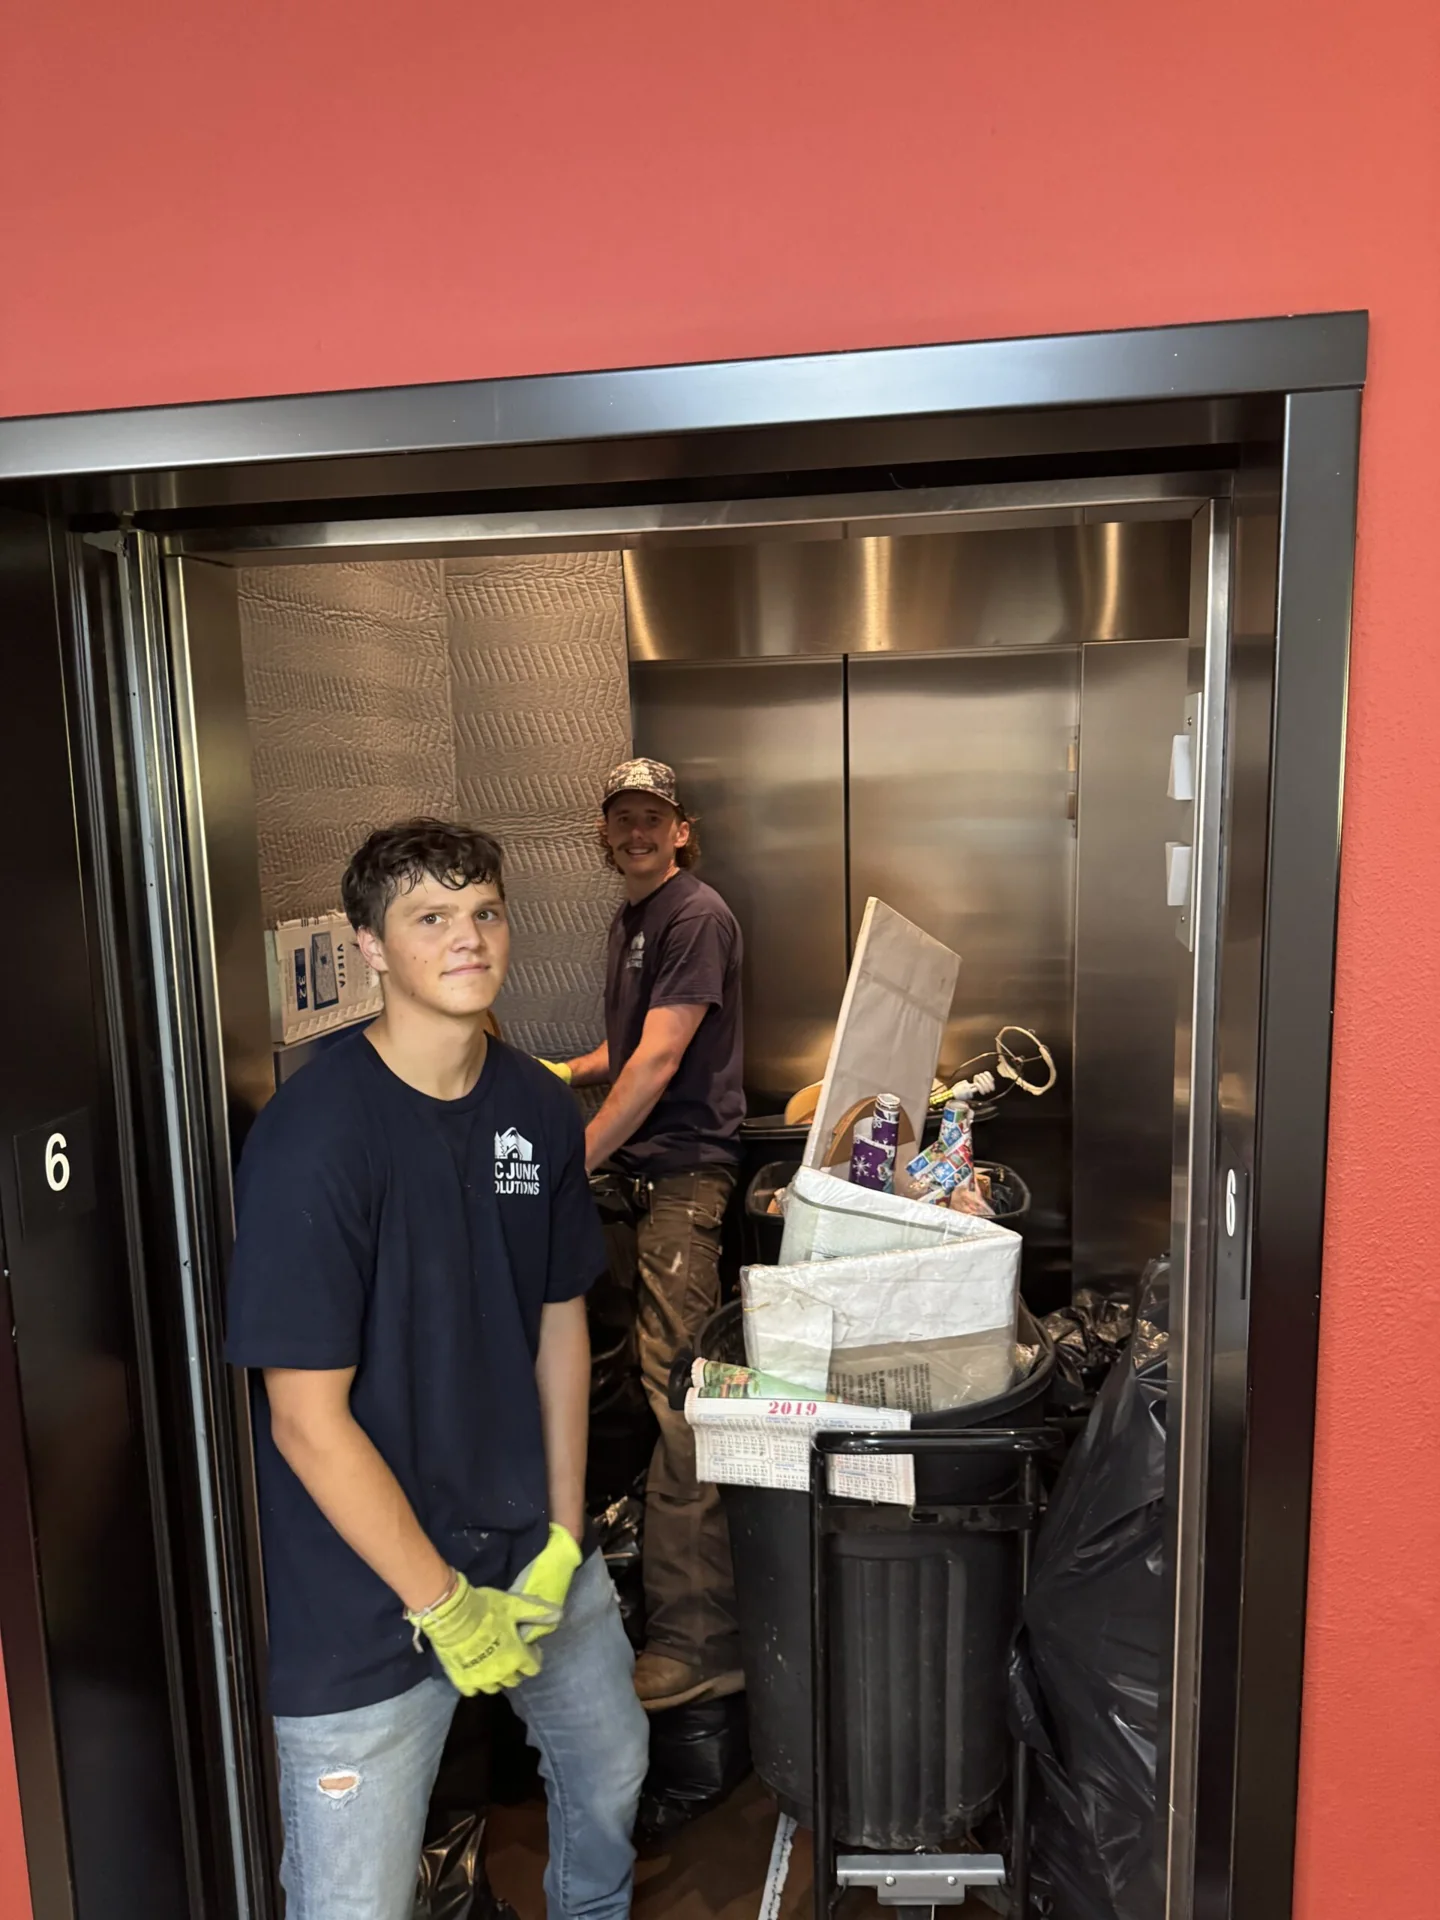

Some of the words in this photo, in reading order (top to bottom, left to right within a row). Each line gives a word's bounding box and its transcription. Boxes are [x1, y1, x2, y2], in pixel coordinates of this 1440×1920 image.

[45, 1132, 70, 1192] 6
[506, 1162, 540, 1181] JUNK
[1226, 1168, 1236, 1237] 6
[768, 1401, 817, 1416] 2019
